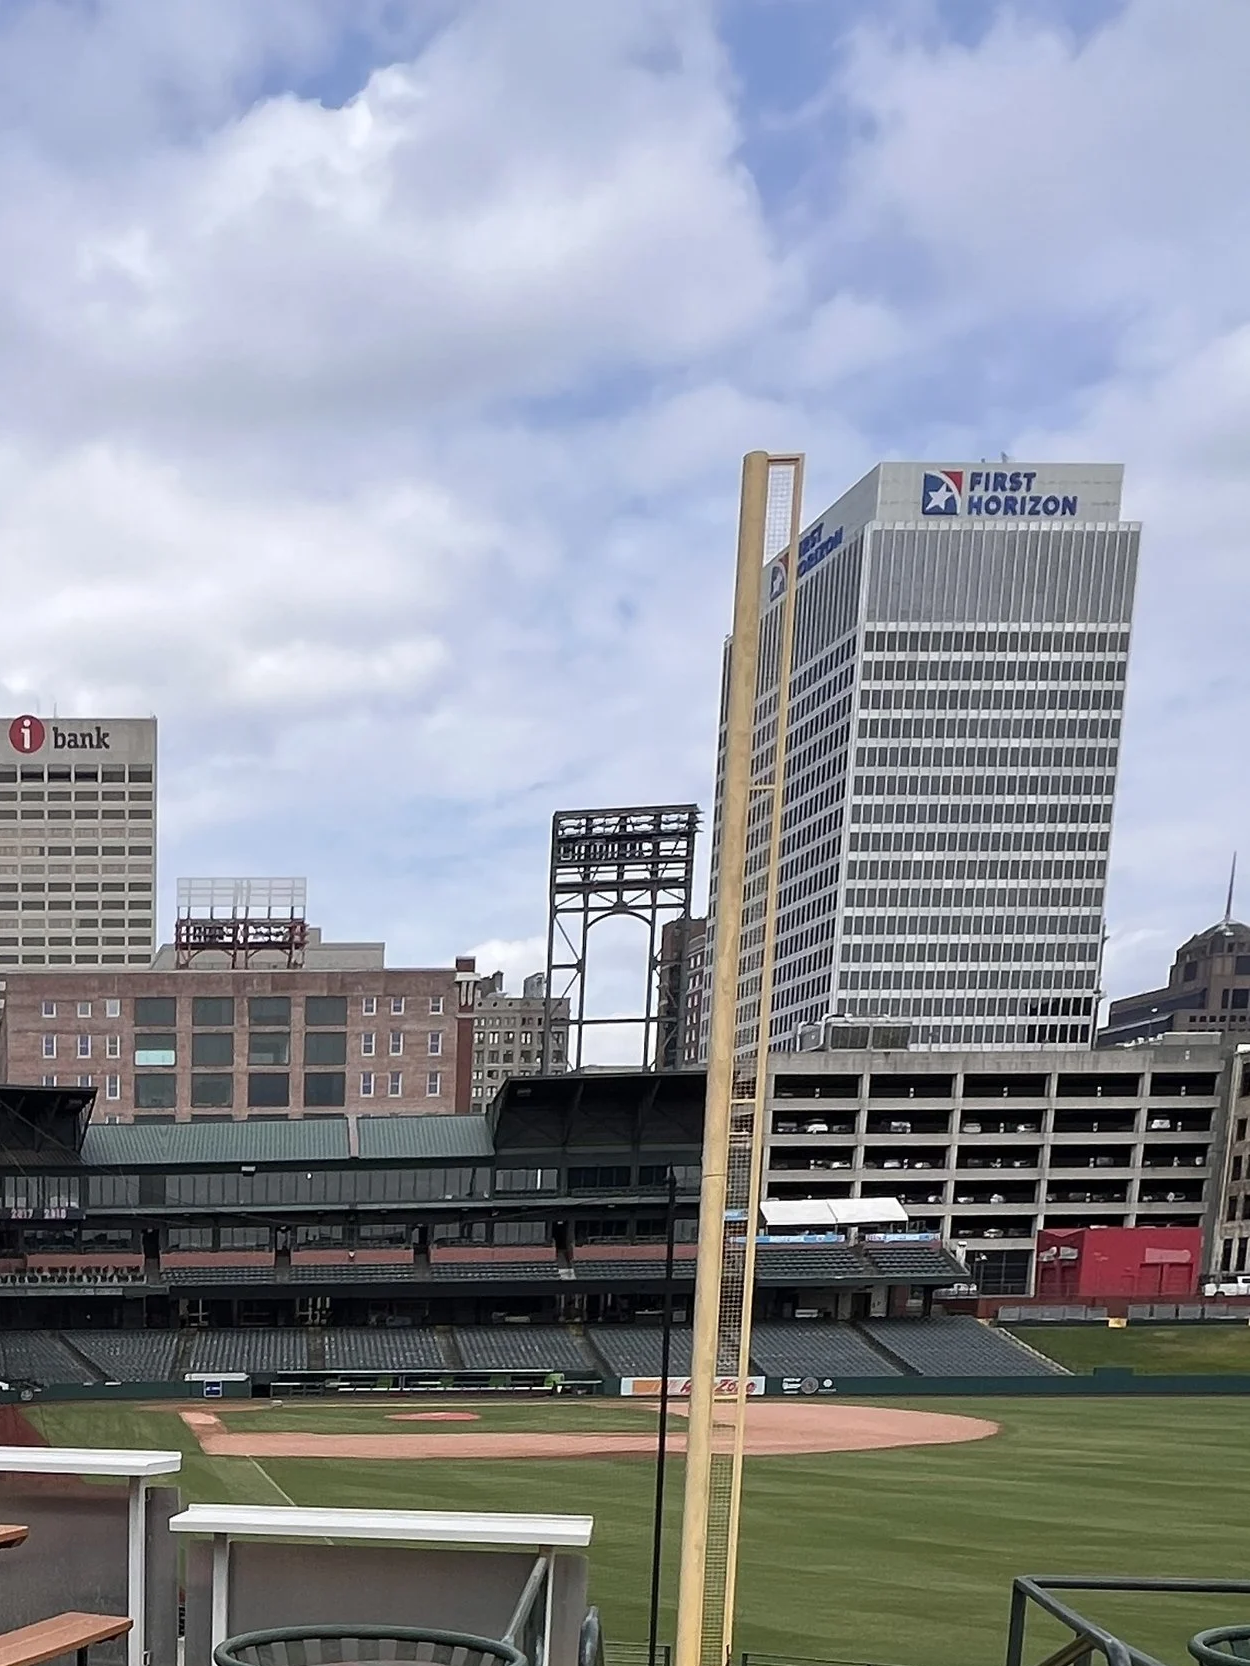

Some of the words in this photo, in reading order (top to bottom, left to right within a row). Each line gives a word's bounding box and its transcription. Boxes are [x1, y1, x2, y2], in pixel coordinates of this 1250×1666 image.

[969, 472, 1037, 493] FIRST
[967, 495, 1079, 516] HORIZON
[797, 526, 844, 579] ORIZON
[52, 726, 110, 750] bank
